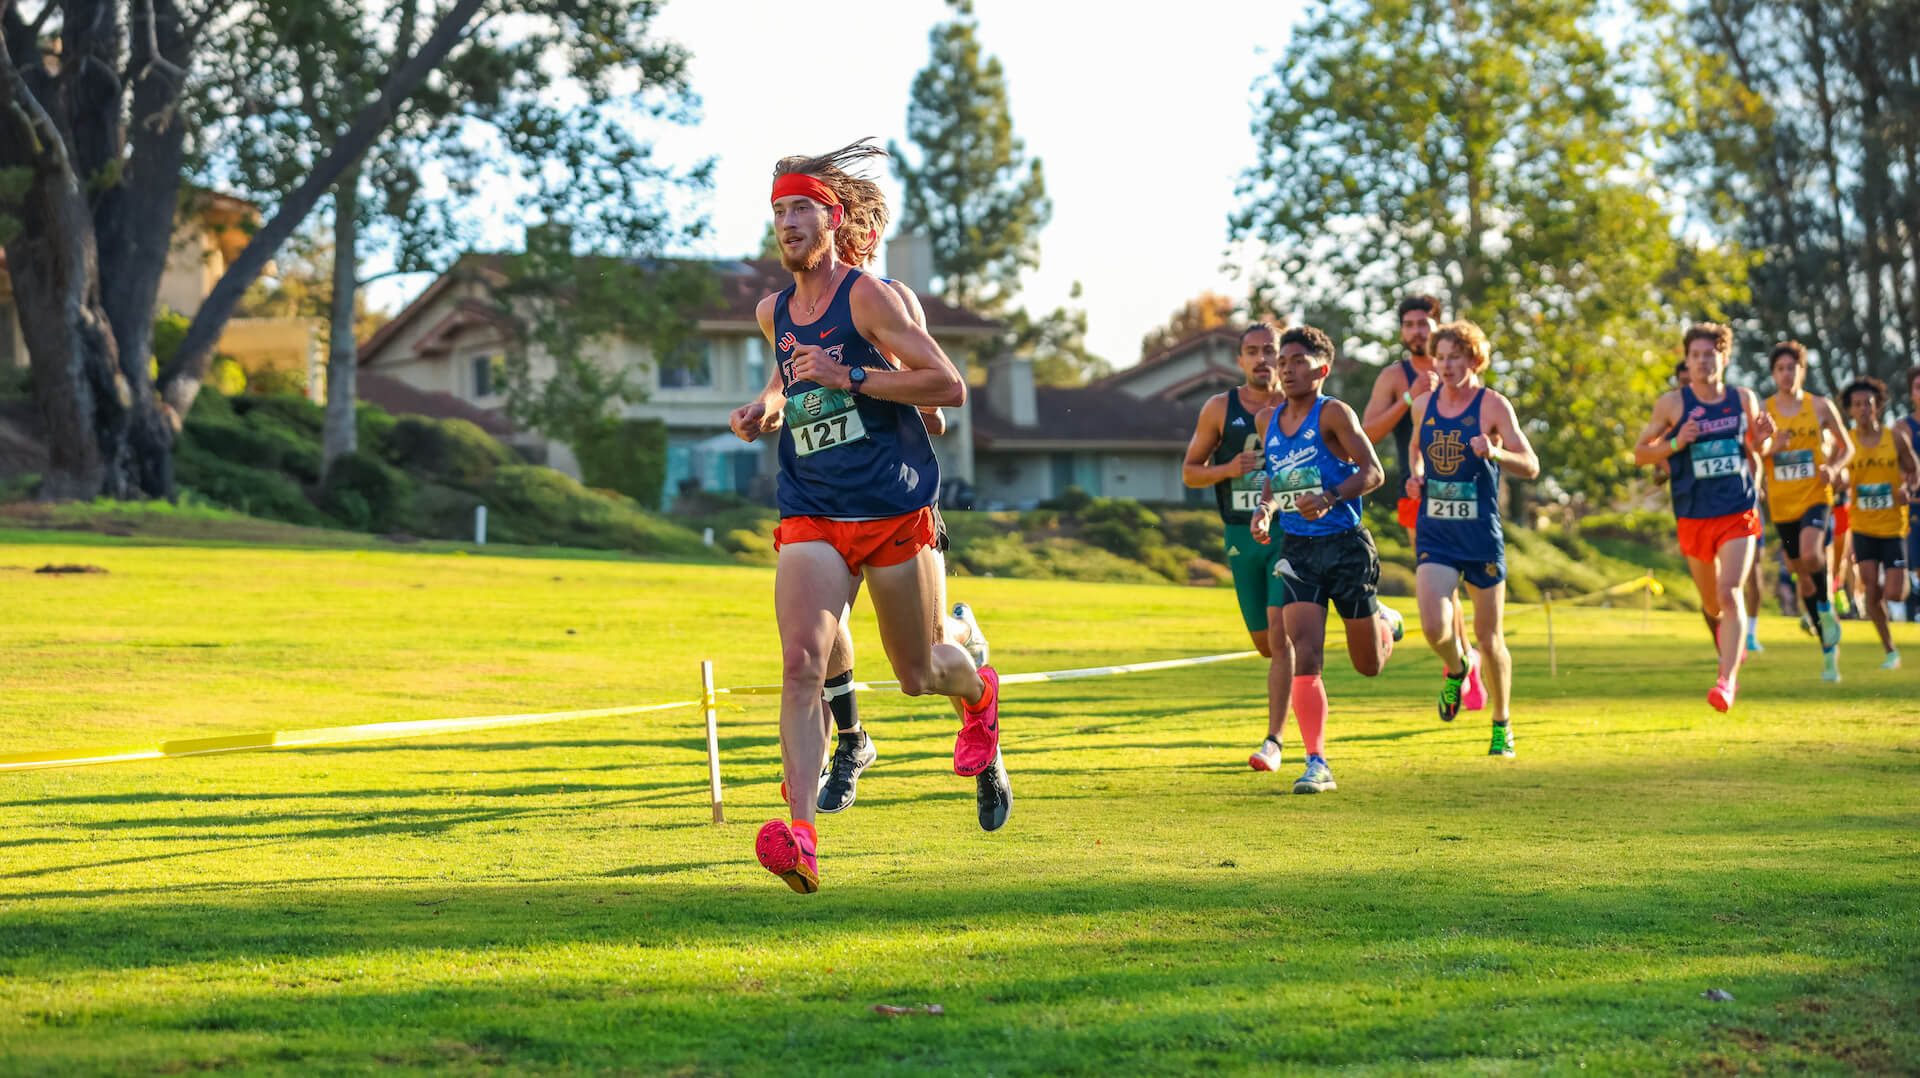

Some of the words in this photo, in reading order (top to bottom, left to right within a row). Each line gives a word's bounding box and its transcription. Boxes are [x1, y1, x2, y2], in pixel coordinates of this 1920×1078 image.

[800, 415, 849, 451] 127
[1701, 458, 1736, 474] 124
[1781, 463, 1809, 478] 178
[1433, 502, 1470, 517] 218
